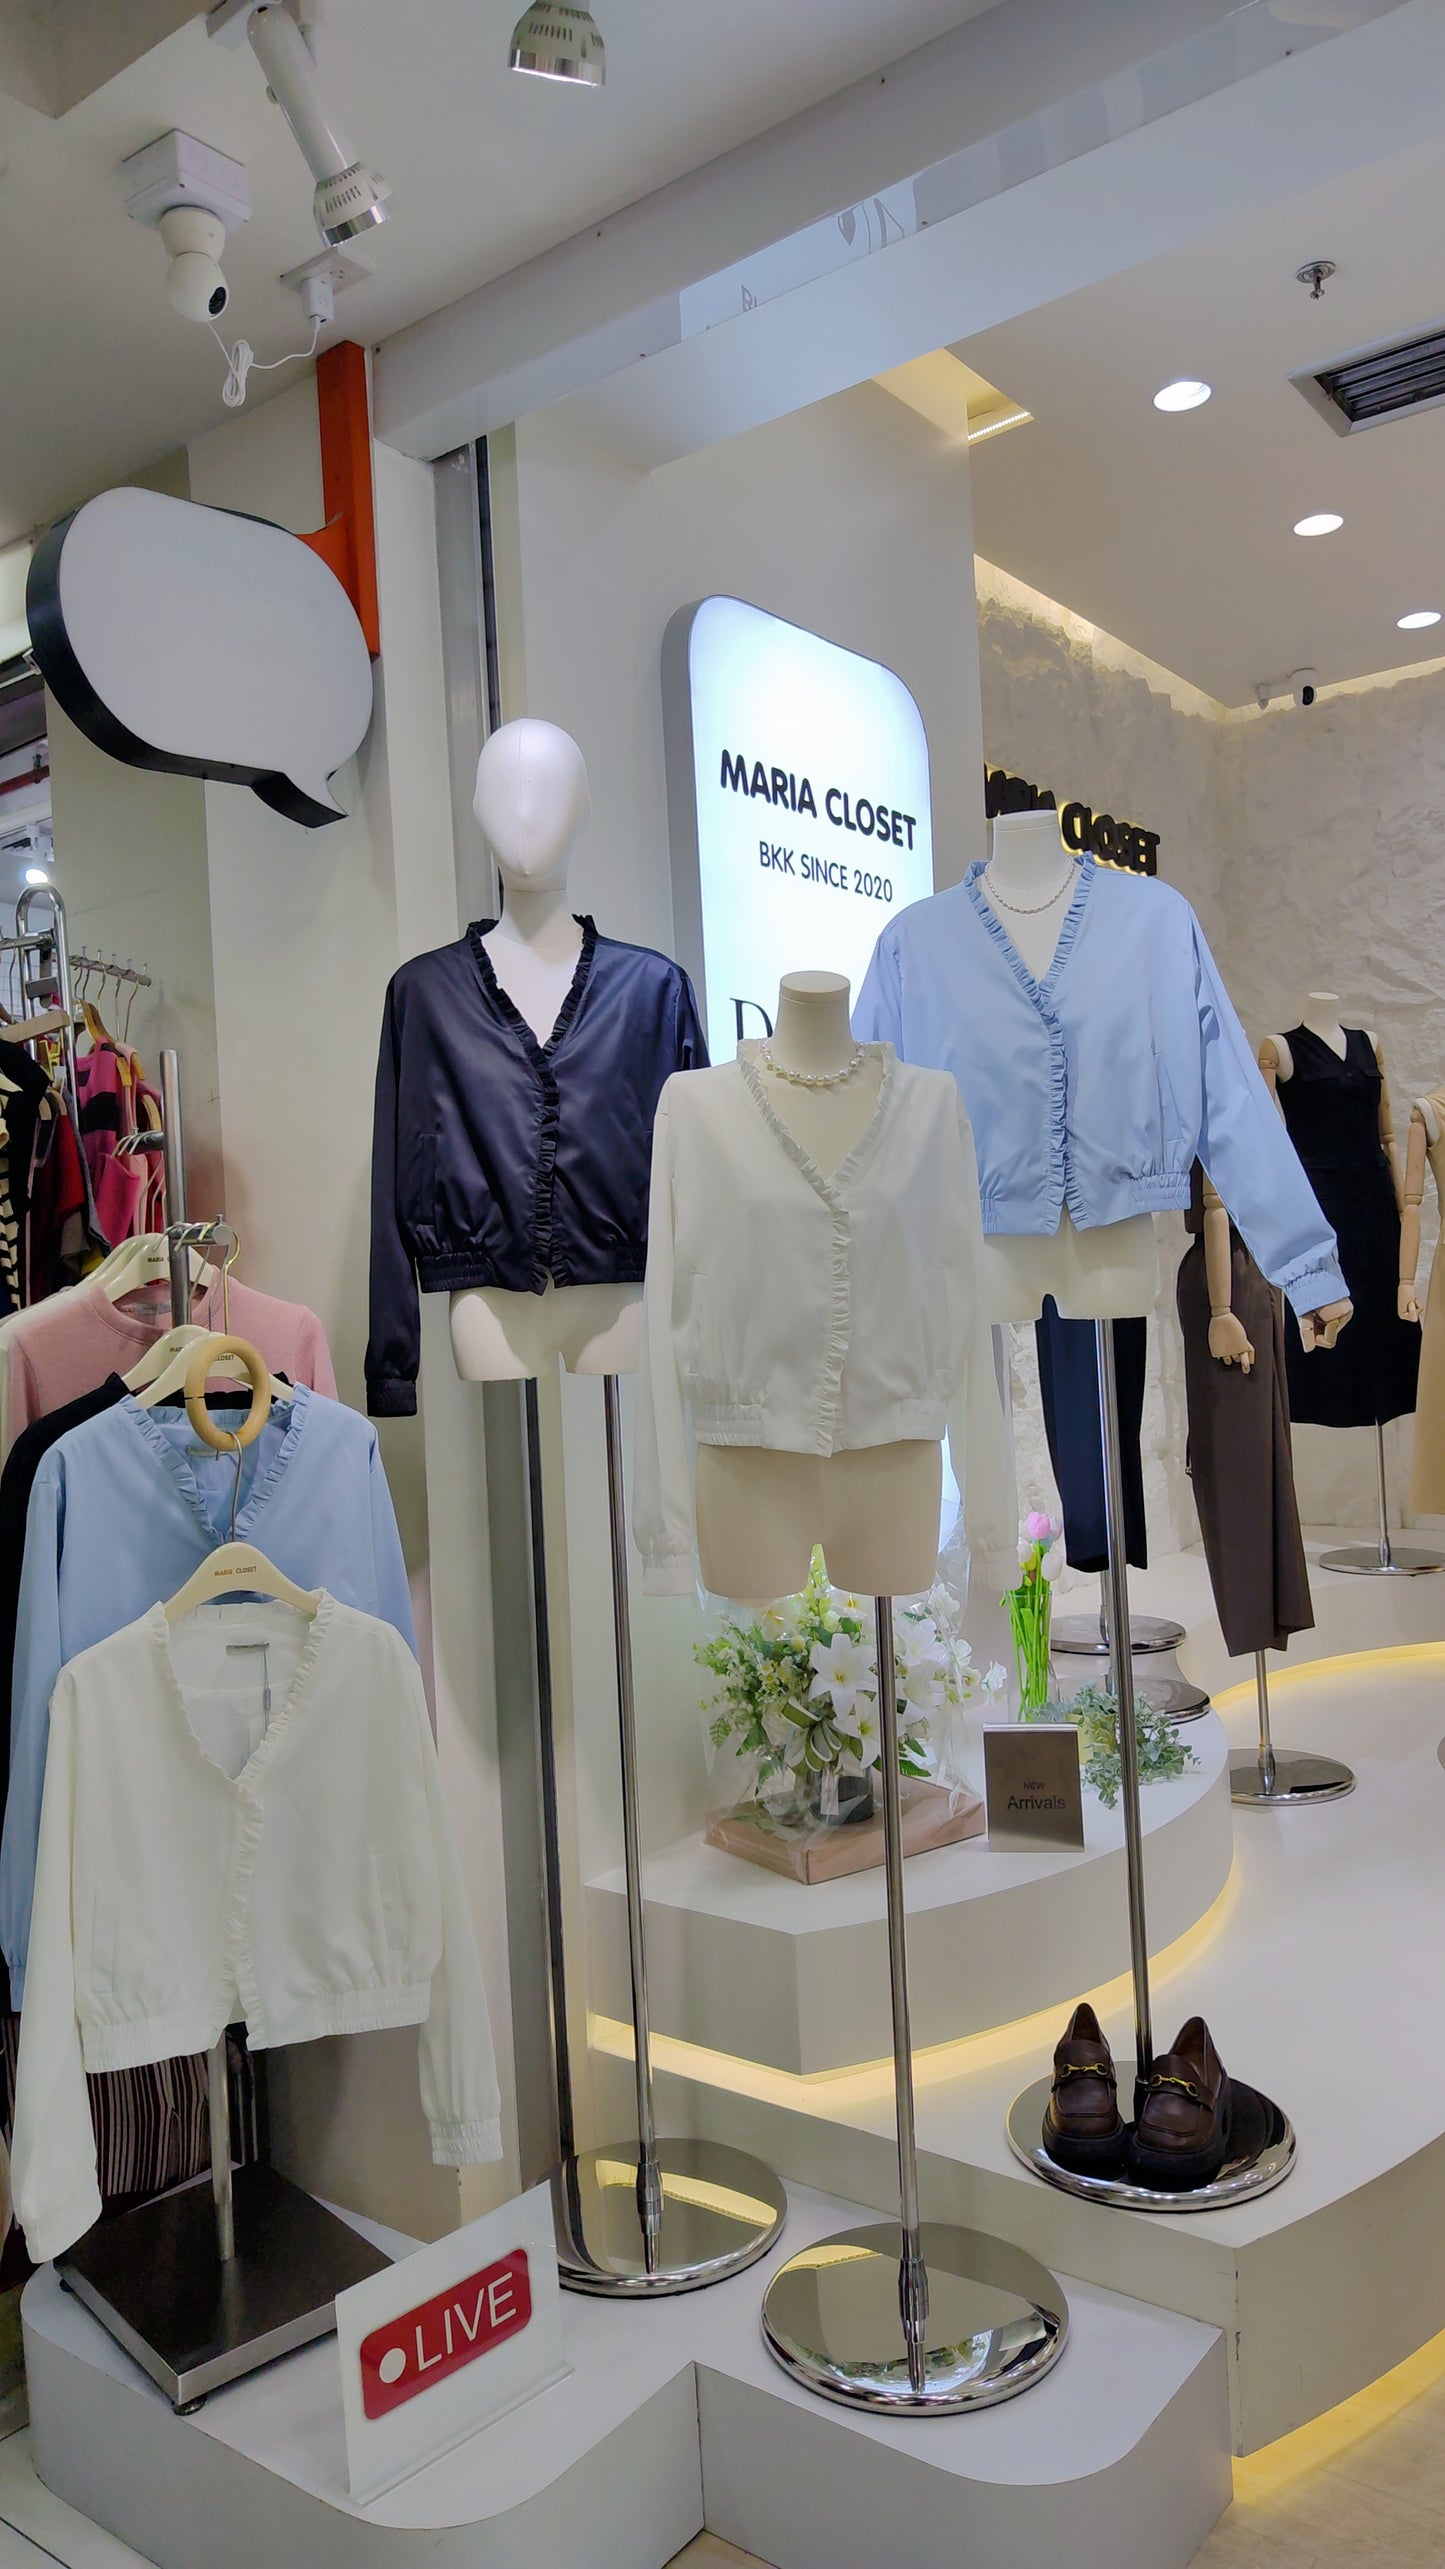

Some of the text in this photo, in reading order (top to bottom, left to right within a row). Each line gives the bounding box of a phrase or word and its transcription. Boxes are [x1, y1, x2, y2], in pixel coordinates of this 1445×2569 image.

[720, 749, 917, 851] MARIA CLOSET
[759, 841, 893, 902] BKK SINCE 2020
[236, 1566, 257, 1574] CLOSET
[1007, 1795, 1066, 1810] Arrivals
[1023, 1781, 1045, 1790] NEW
[415, 2271, 517, 2372] LIVE
